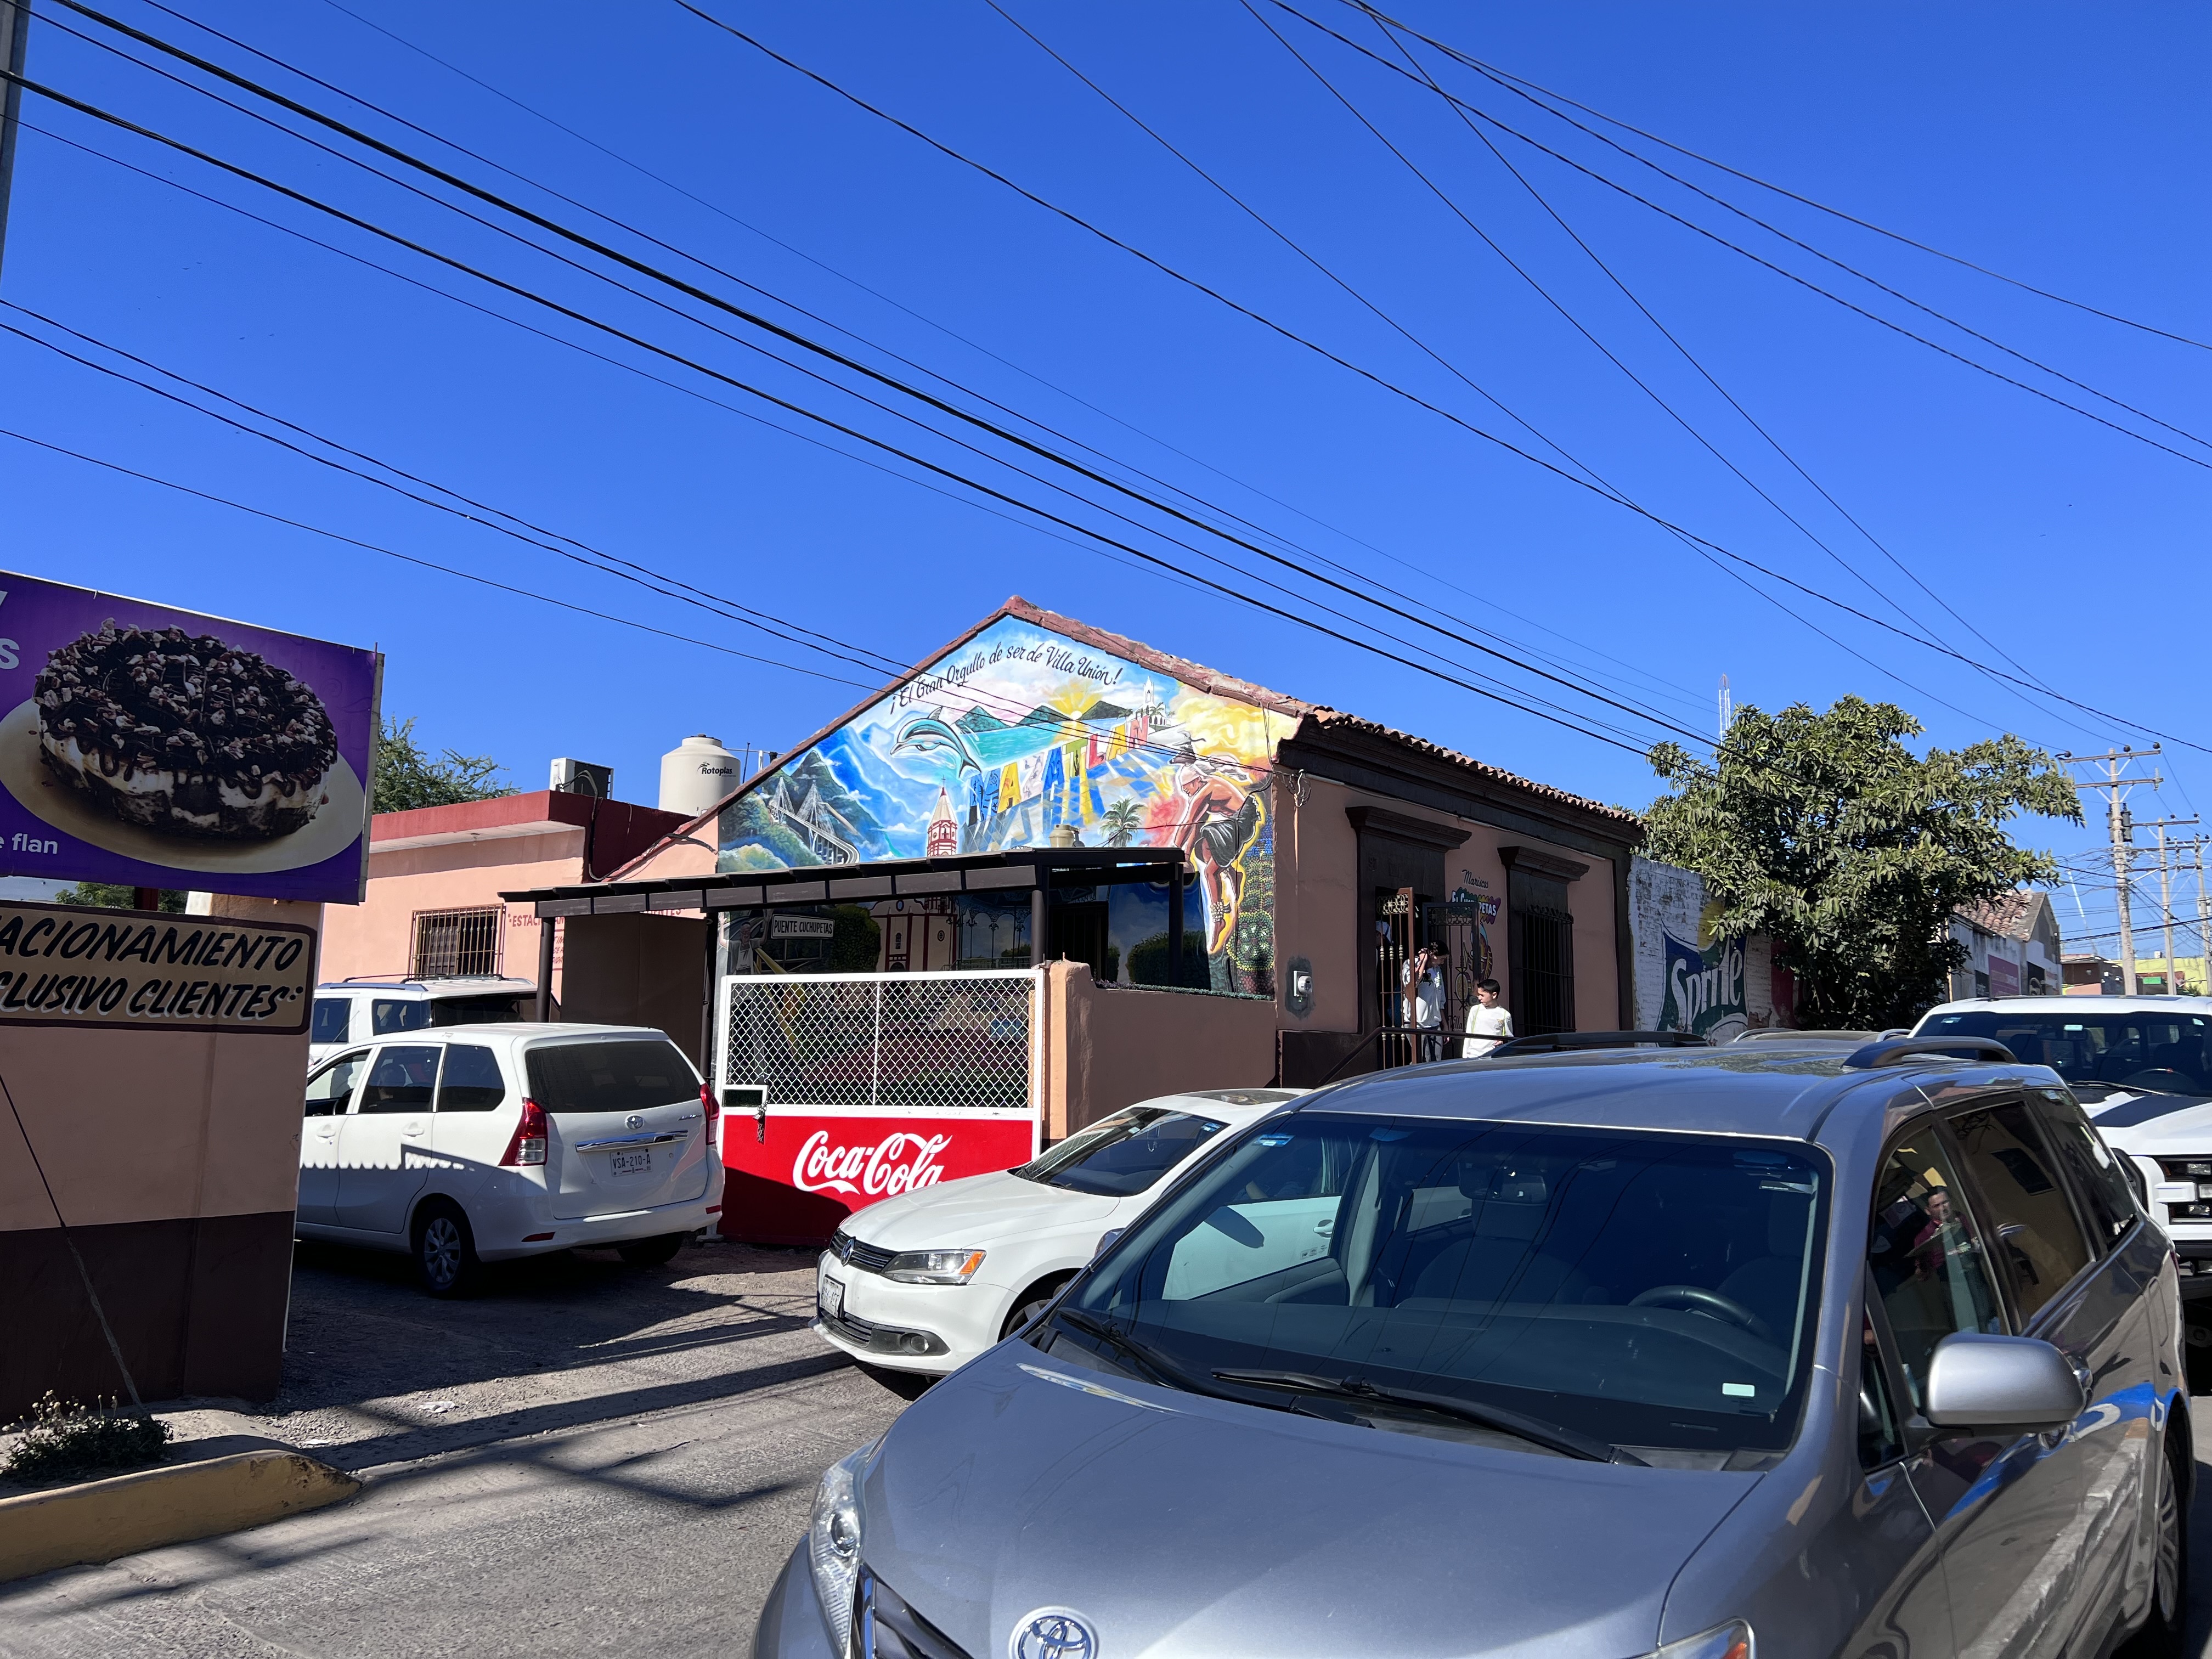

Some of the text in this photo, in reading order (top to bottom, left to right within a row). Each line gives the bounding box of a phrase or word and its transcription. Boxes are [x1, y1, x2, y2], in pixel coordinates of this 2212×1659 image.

[916, 676, 943, 698] Gran
[946, 651, 985, 687] Orgullo
[989, 641, 1003, 665] de
[1006, 645, 1027, 659] ser
[1026, 642, 1045, 663] de
[1046, 646, 1076, 674] Villa
[702, 766, 732, 776] Rotoplas
[967, 715, 1149, 826] MAZATLAN
[12, 833, 58, 855] flan
[1462, 869, 1489, 889] Mariscos
[774, 919, 833, 935] PUENTE CUCHUPETAS
[1668, 935, 1743, 1033] Sprite
[612, 1154, 651, 1169] VSA-210-A
[793, 1130, 953, 1195] Coca-Cola
